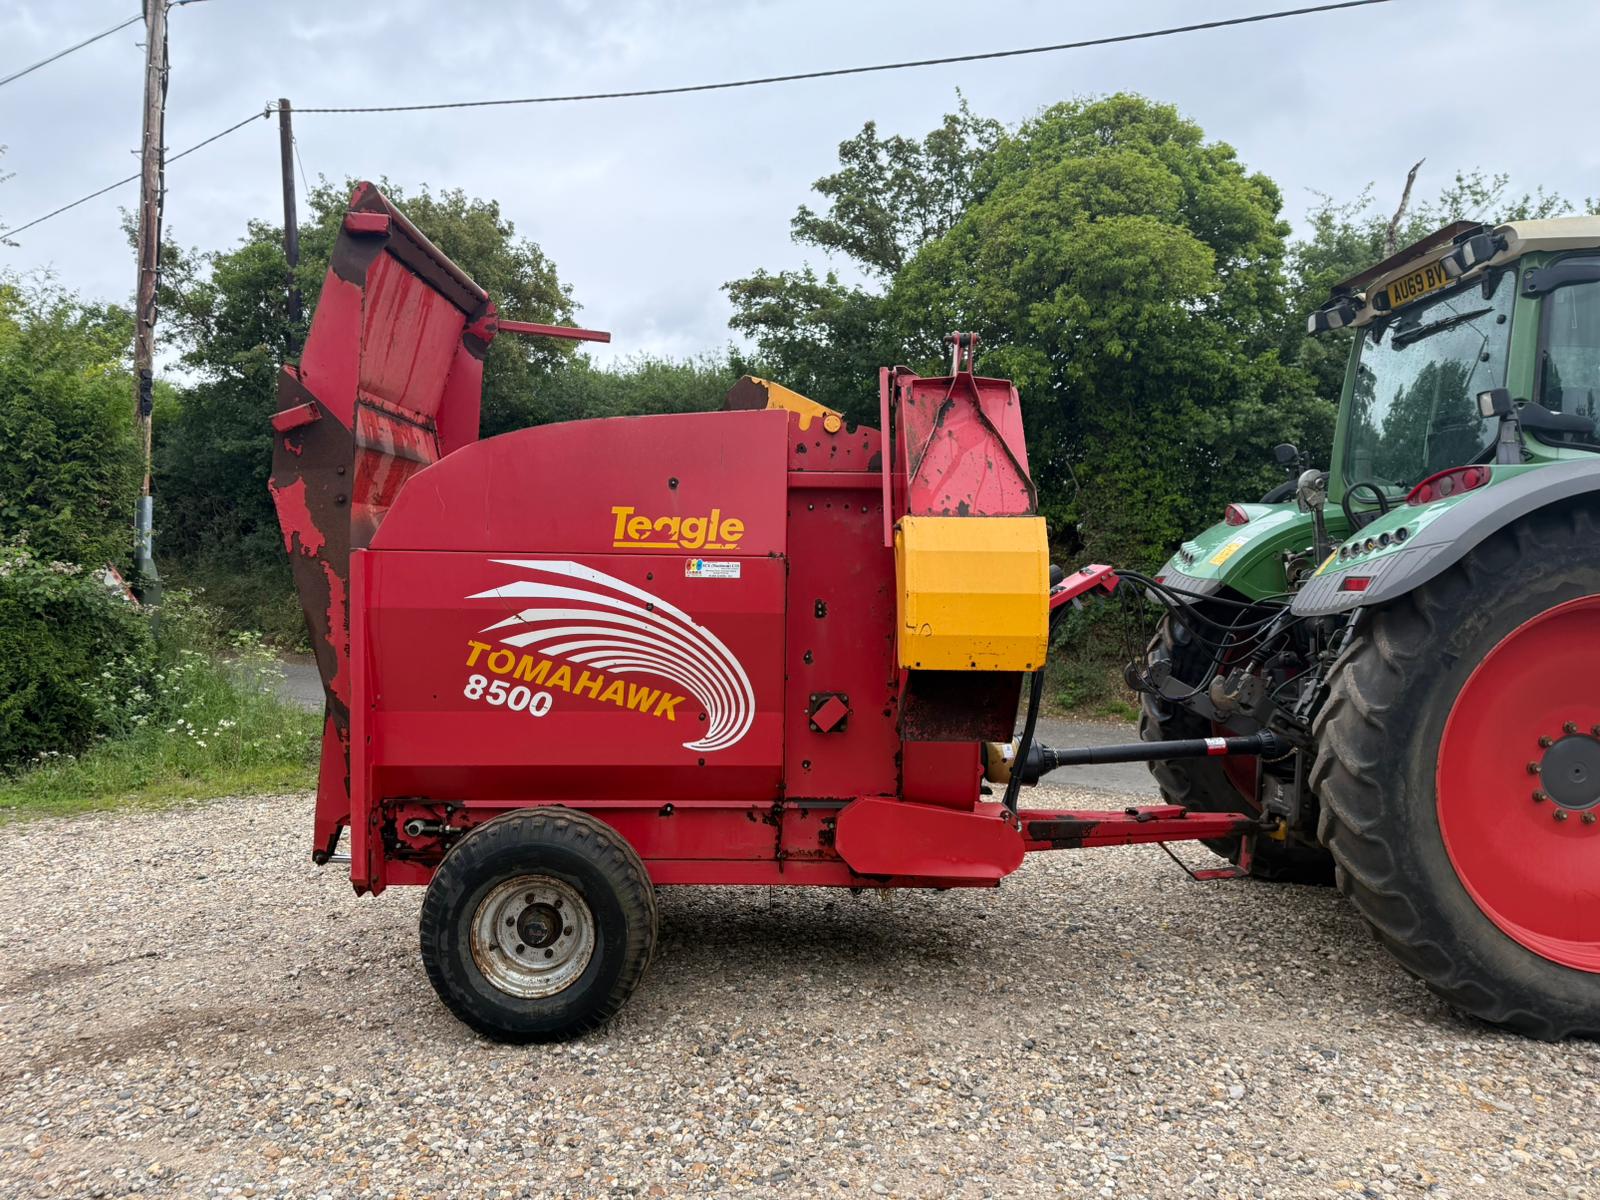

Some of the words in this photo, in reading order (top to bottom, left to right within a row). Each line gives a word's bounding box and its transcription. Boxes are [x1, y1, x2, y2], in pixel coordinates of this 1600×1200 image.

[1394, 273, 1424, 303] AU69
[1425, 264, 1448, 288] BV
[611, 506, 745, 549] Teagle
[463, 674, 553, 717] 8500
[465, 640, 686, 721] TOMAHAWK
